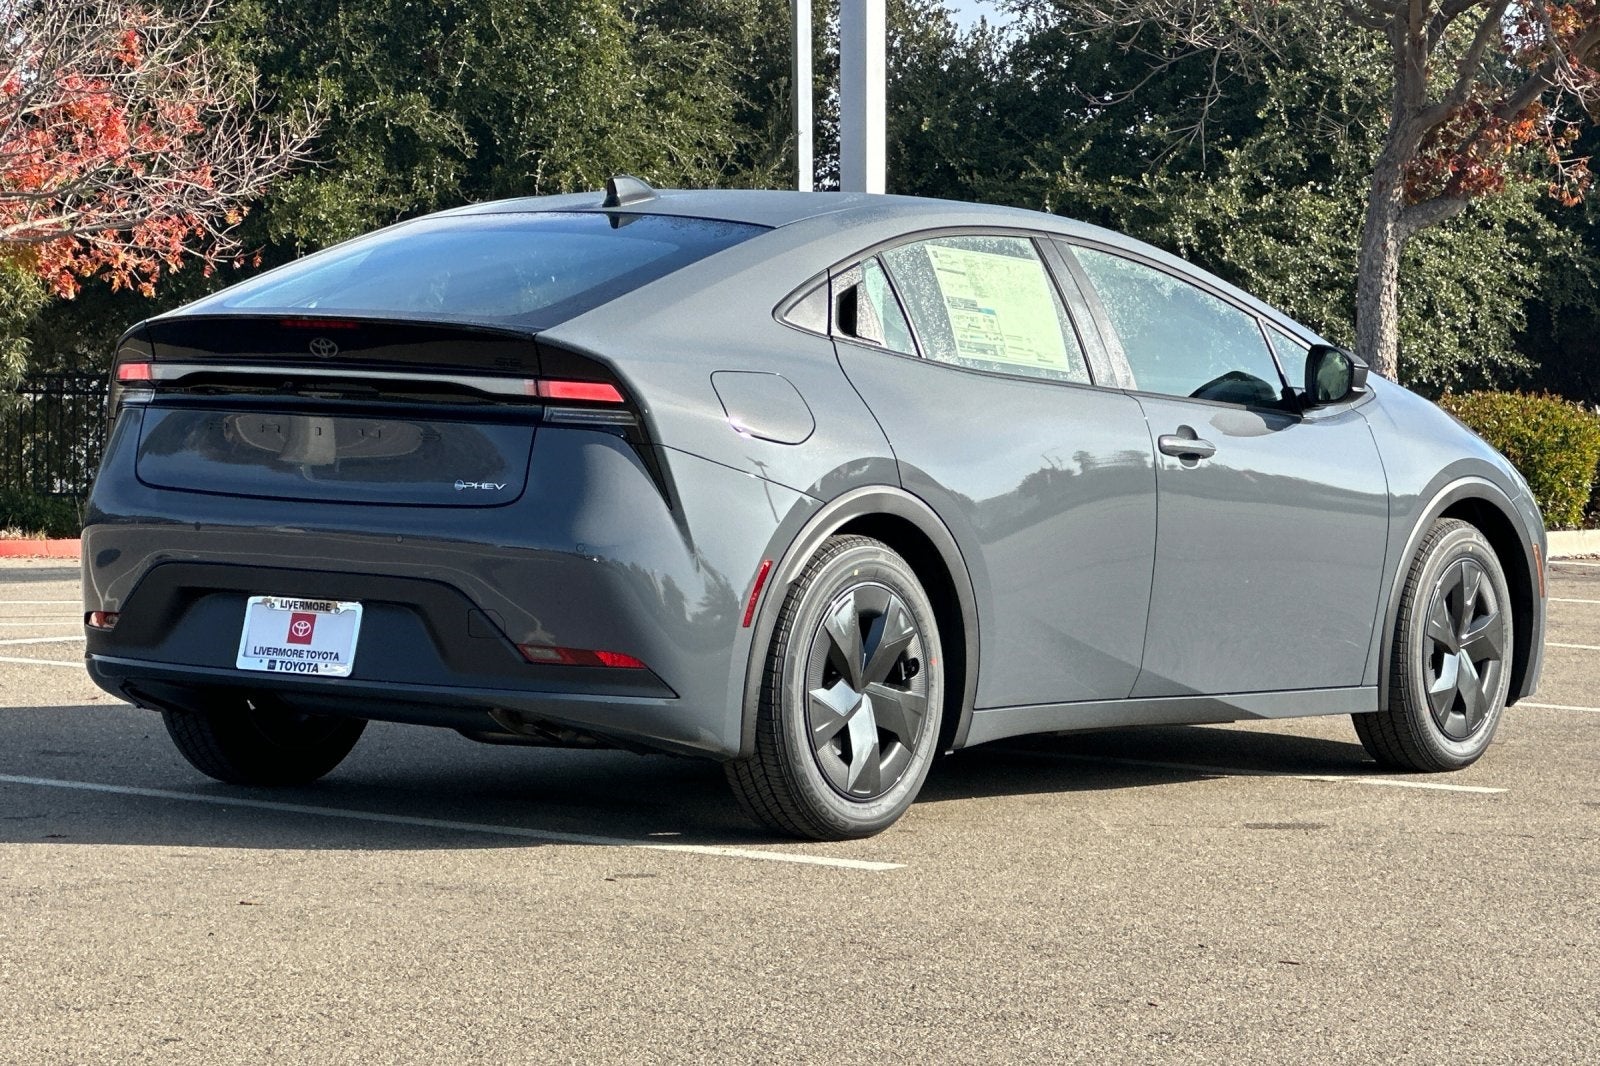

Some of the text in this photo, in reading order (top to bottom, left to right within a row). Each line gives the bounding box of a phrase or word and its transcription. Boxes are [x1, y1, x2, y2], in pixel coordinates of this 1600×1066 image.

[464, 481, 507, 491] PHEV
[280, 600, 331, 611] LIVERMORE
[253, 646, 339, 661] LIVERMORE TOYOTA
[279, 660, 319, 673] TOYOTA
